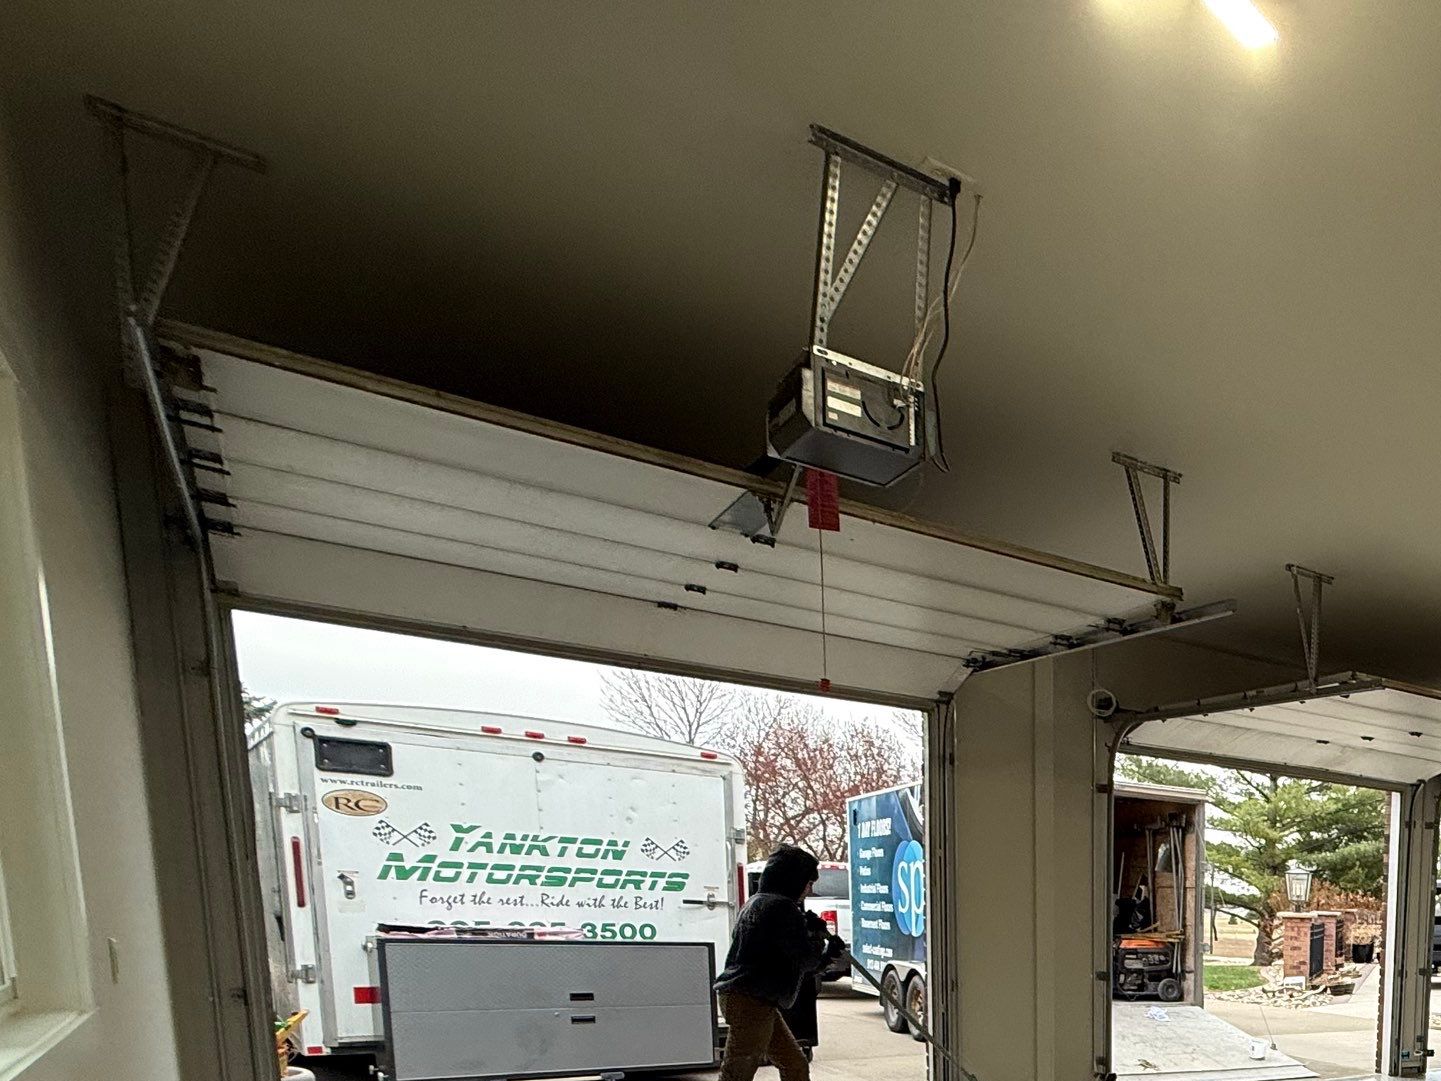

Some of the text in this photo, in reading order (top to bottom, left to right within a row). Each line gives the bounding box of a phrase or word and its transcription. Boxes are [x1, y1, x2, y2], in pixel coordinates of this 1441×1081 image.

[320, 777, 423, 791] www.rctrailers.com
[333, 796, 383, 812] RC
[448, 823, 630, 861] YANKTON
[376, 852, 690, 892] MOTORSPORTS
[419, 889, 466, 910] Forget
[470, 891, 492, 906] the
[576, 895, 606, 909] with
[610, 895, 629, 909] the
[633, 896, 665, 911] Best!
